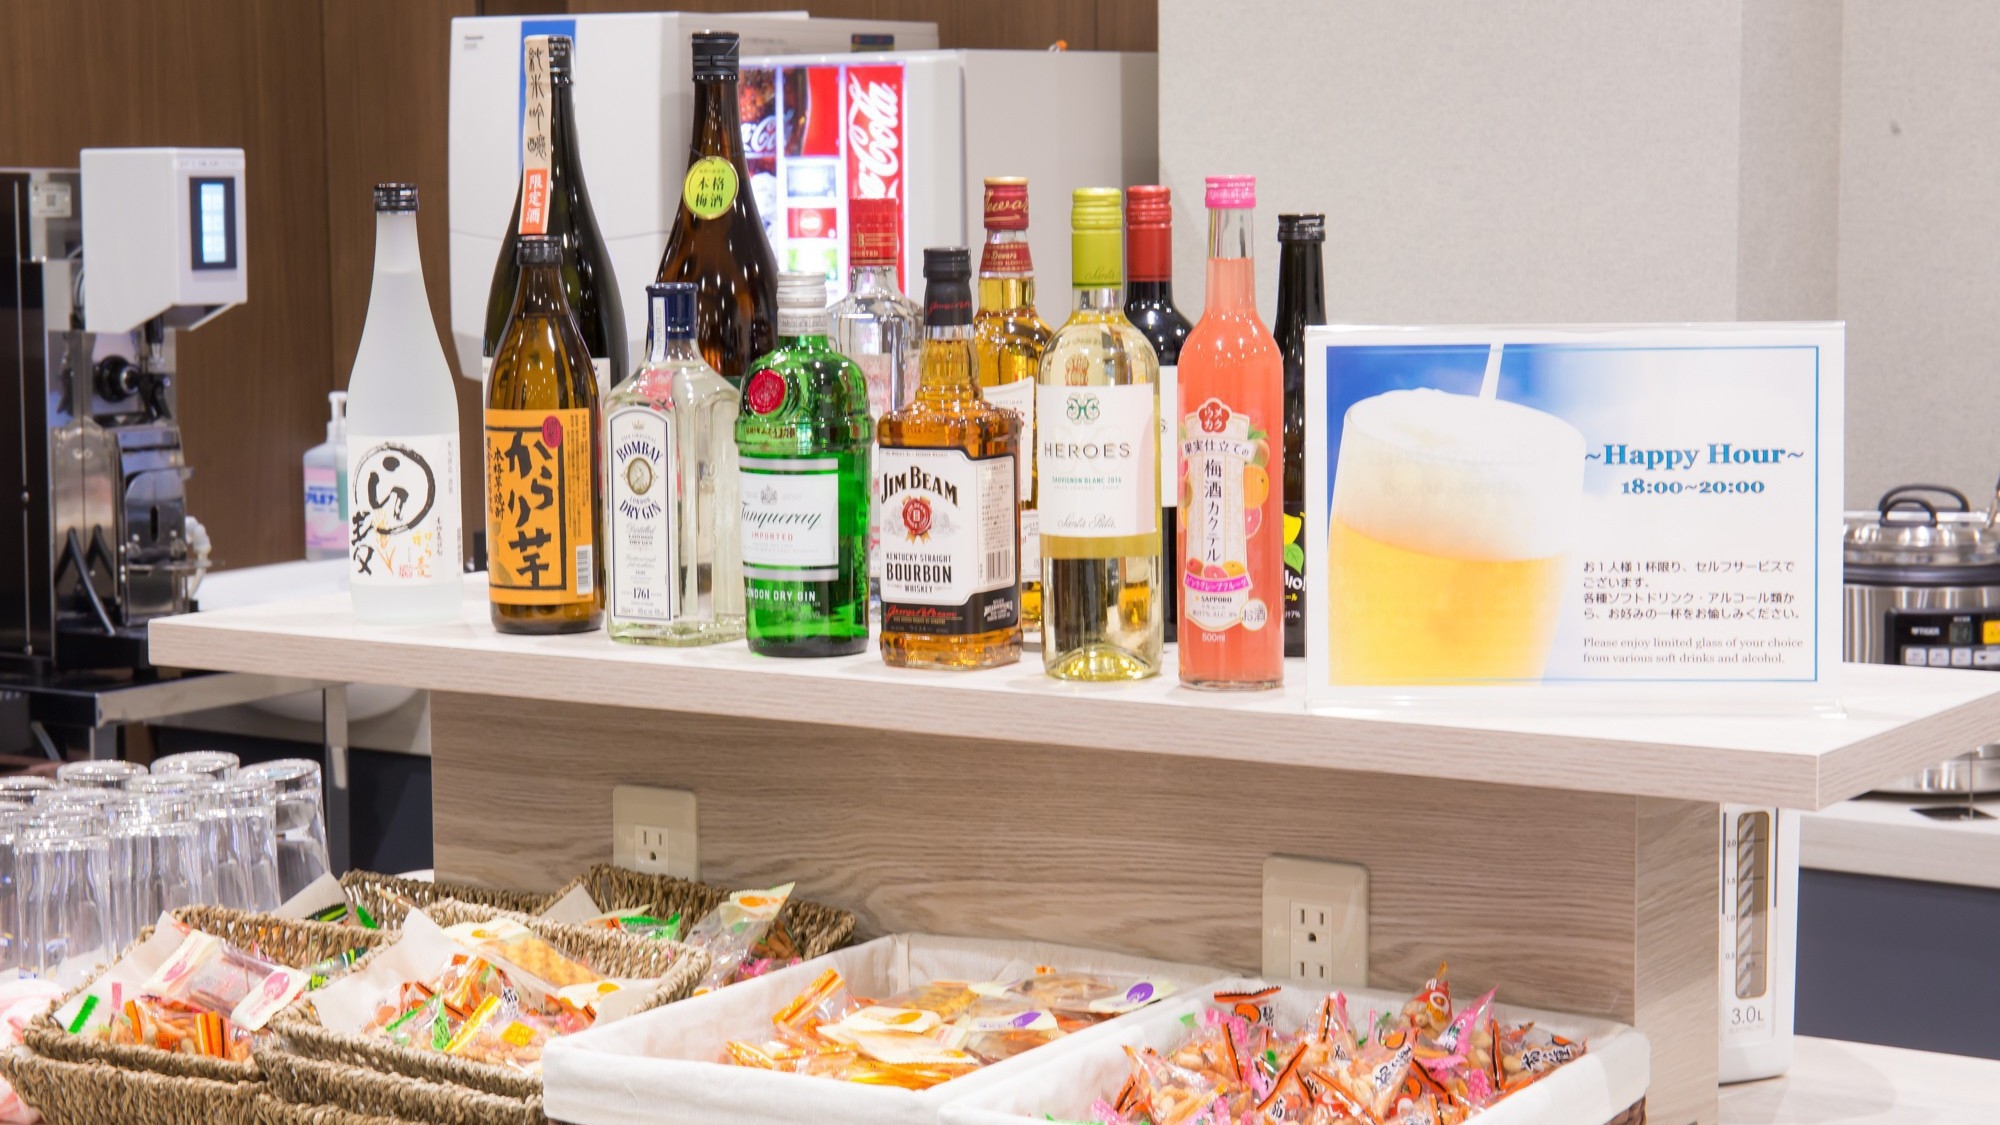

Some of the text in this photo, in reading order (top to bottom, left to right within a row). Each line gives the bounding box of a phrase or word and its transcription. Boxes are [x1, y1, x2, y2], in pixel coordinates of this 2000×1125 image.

[697, 176, 725, 191] 本格
[525, 173, 544, 226] 限定酒
[695, 193, 723, 208] 梅酒
[616, 441, 663, 464] BOMBAY
[1044, 443, 1132, 459] HEROES
[1184, 440, 1250, 456] 果実仕立ての
[881, 466, 958, 508] JIM BEAM
[620, 500, 662, 520] DRY GIN
[741, 501, 822, 531] Tanqueray
[1204, 459, 1223, 562] 梅酒カクテル
[1056, 512, 1086, 530] Santa
[751, 531, 794, 542] IMPORTED
[886, 551, 951, 563] KENTUCKY STRAIGHT
[886, 562, 952, 583] BOURBON
[904, 584, 933, 593] WHISKEY
[1583, 577, 1650, 589] ございます。
[633, 587, 650, 599] 1761
[773, 590, 793, 601] DRY
[797, 591, 816, 602] GIN
[1201, 594, 1232, 604] SAPPORO
[1241, 604, 1266, 621] お酒
[1583, 637, 1804, 652] Please enjoy limited glass of your choice
[1583, 652, 1786, 664] from various soft drinks and alcohol.
